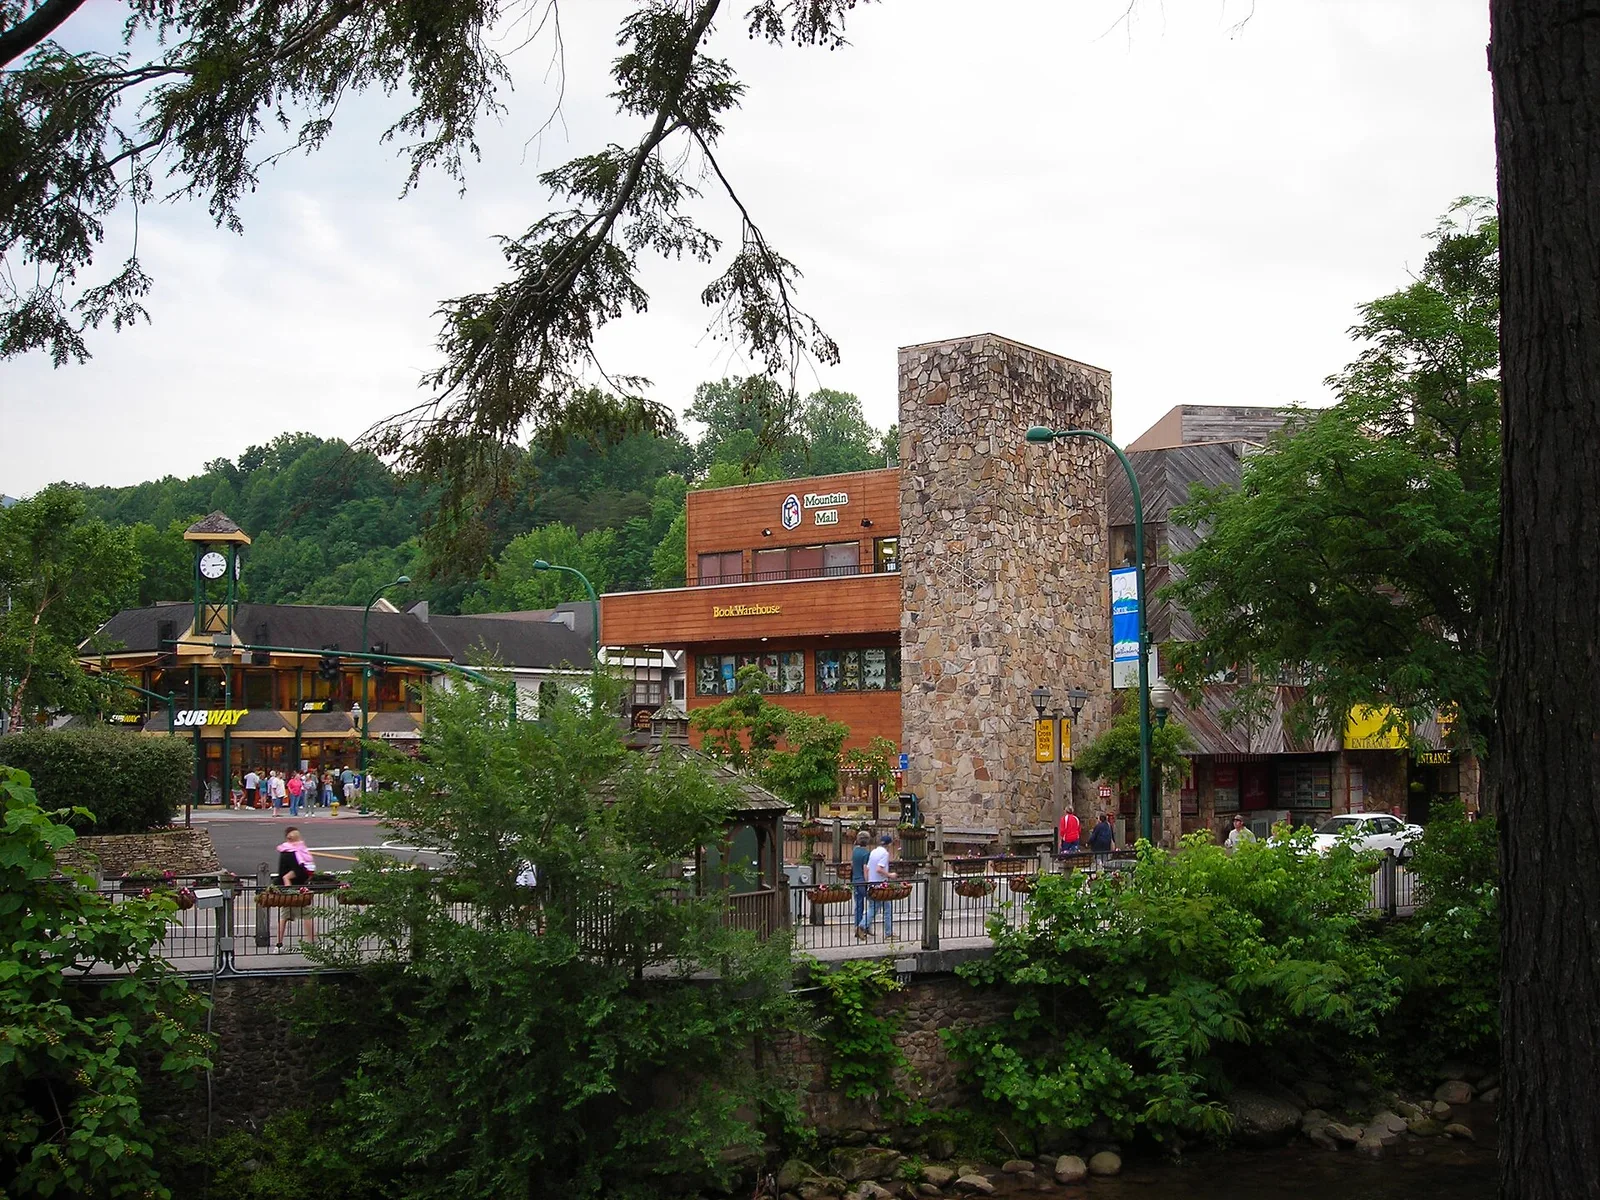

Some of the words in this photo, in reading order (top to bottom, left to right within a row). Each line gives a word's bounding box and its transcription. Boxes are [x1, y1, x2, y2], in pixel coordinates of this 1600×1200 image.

[805, 493, 847, 507] Mountain
[816, 511, 837, 524] Mall
[110, 714, 141, 723] SUBWAY
[174, 708, 249, 726] SUBWAY
[1352, 738, 1391, 748] ENTRANCE
[1418, 752, 1451, 763] NTRANCE
